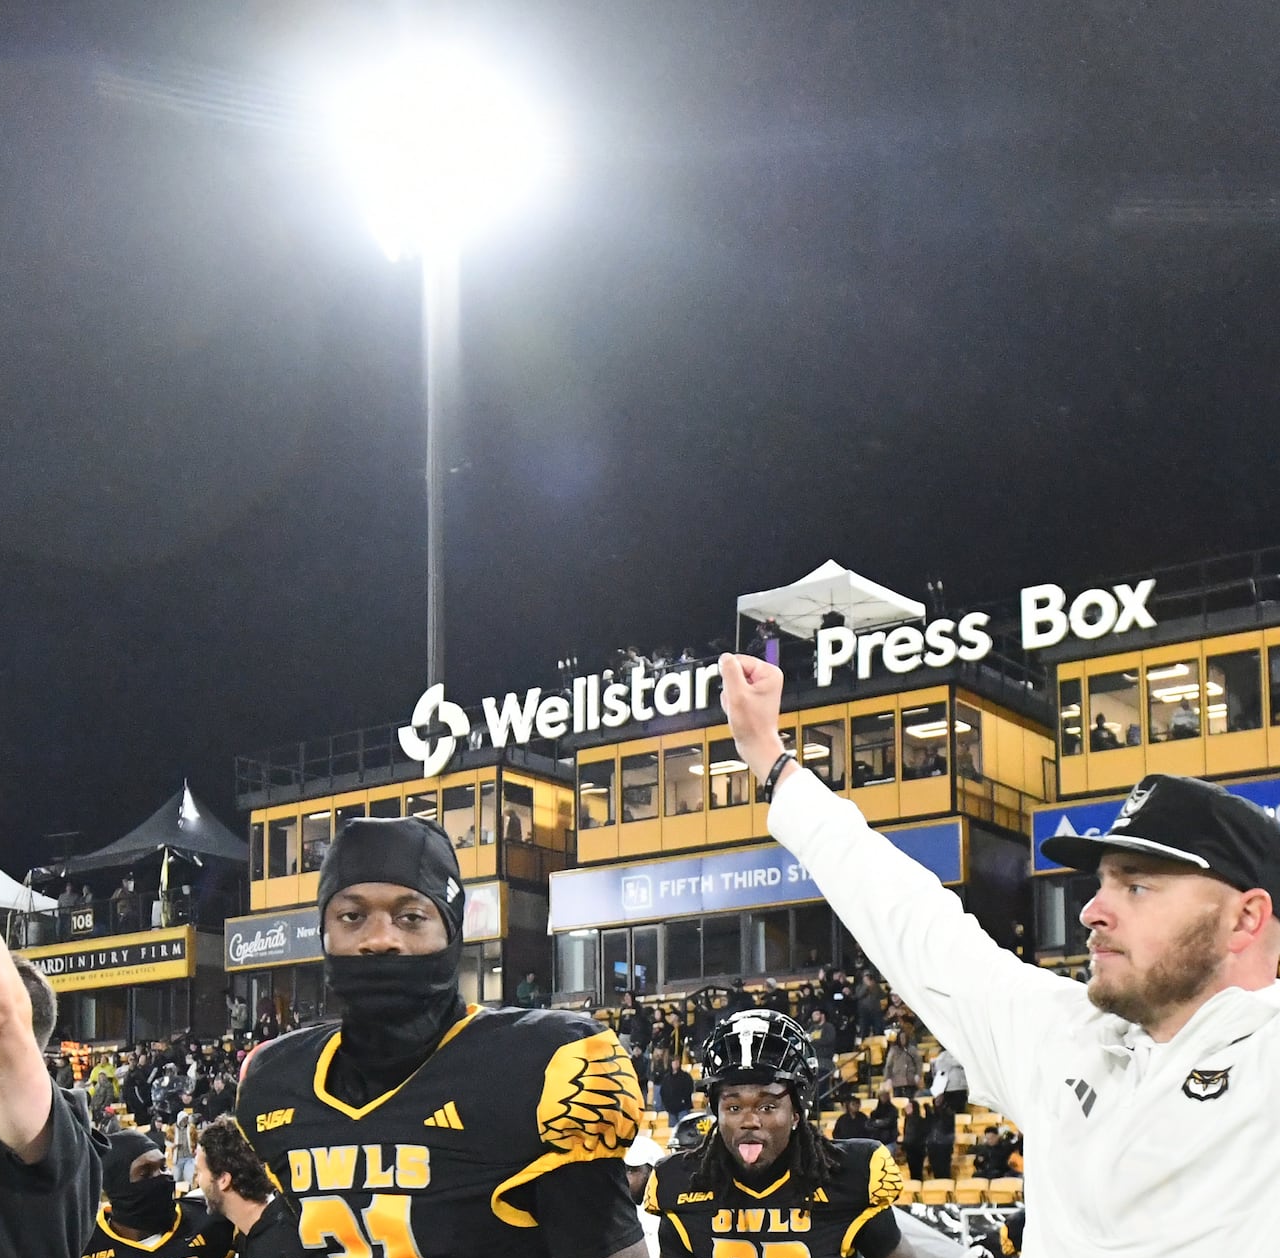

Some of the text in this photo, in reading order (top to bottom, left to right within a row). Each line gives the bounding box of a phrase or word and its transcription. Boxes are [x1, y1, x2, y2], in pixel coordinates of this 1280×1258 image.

[482, 579, 1157, 748] Wellstar Press Box
[659, 863, 813, 898] FIFTH THIRD ST
[72, 913, 94, 930] 108
[296, 926, 315, 939] New
[69, 950, 129, 969] INJURY
[140, 942, 182, 960] FIRM
[287, 1143, 431, 1193] OWLS
[711, 1208, 812, 1233] OWLS
